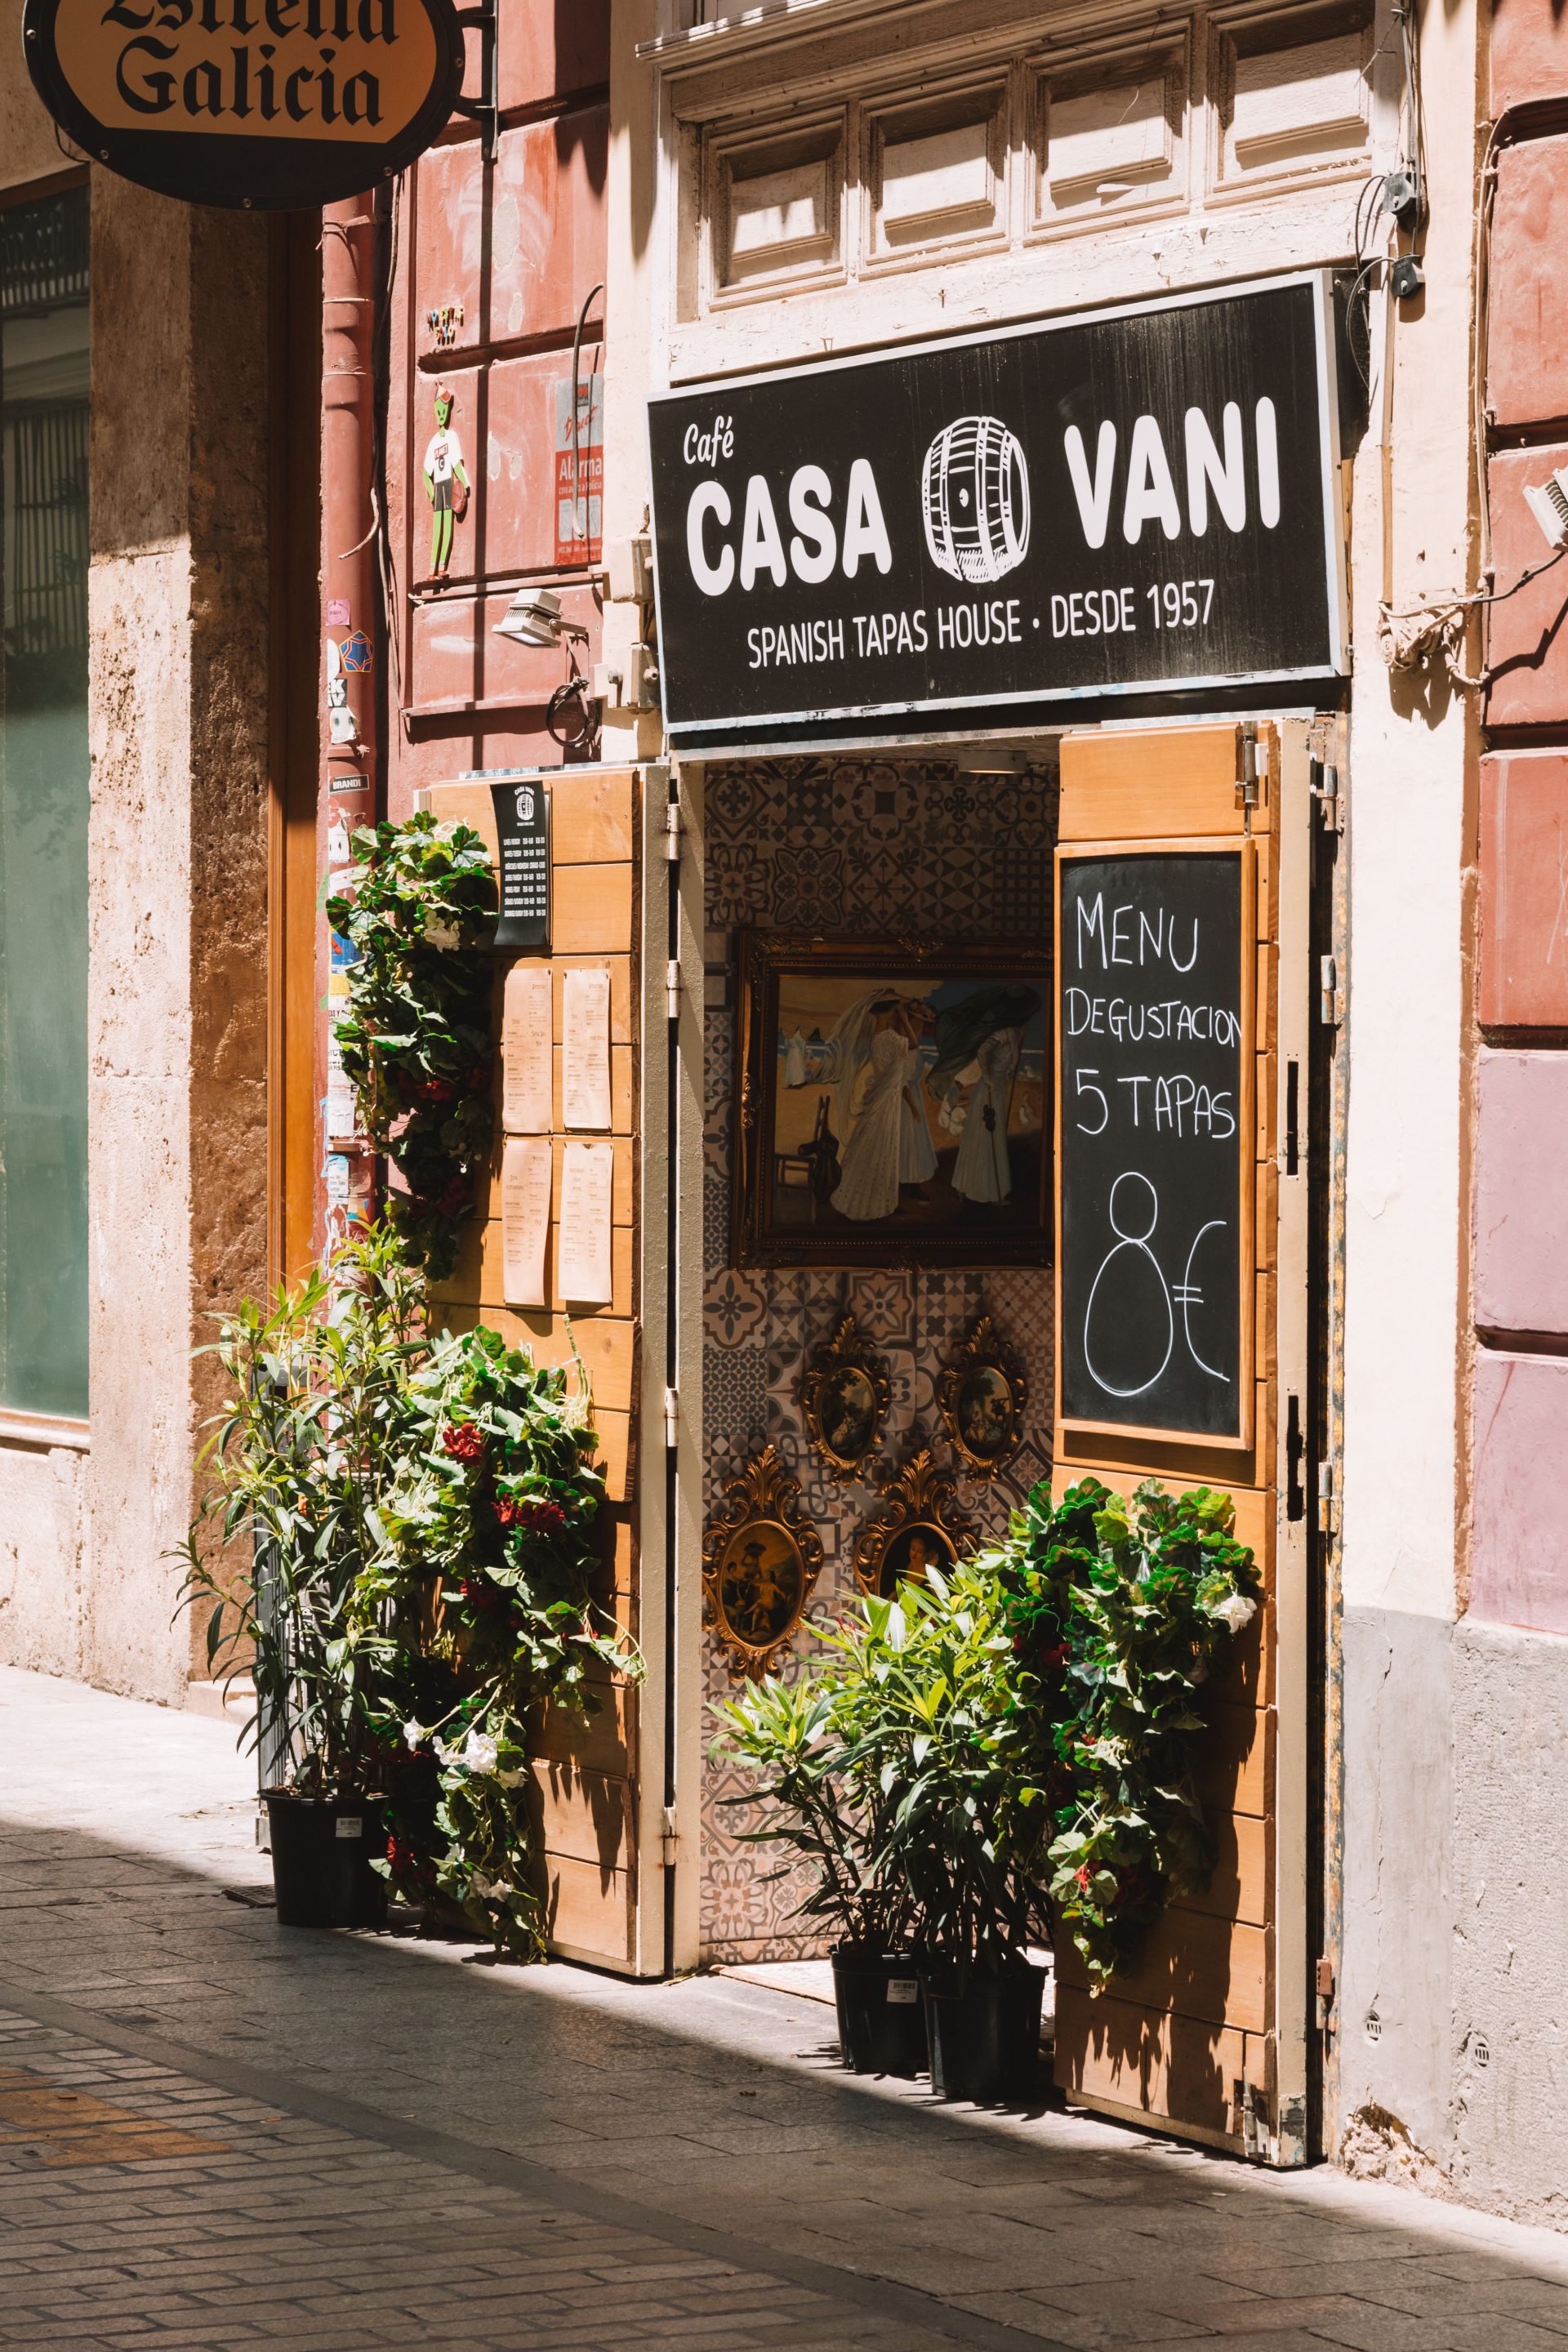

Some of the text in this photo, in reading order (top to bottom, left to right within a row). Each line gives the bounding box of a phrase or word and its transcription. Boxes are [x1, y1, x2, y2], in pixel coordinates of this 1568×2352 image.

[115, 34, 385, 127] Galicia
[682, 414, 735, 469] Café
[686, 399, 1281, 597] CASA VANI
[747, 579, 1215, 669] SPANISH TAPAS HOUSE DESDE 1957
[1077, 892, 1198, 973] MENU
[1066, 987, 1242, 1048] DEGUSTACION
[1076, 1068, 1236, 1139] 5 TAPAS
